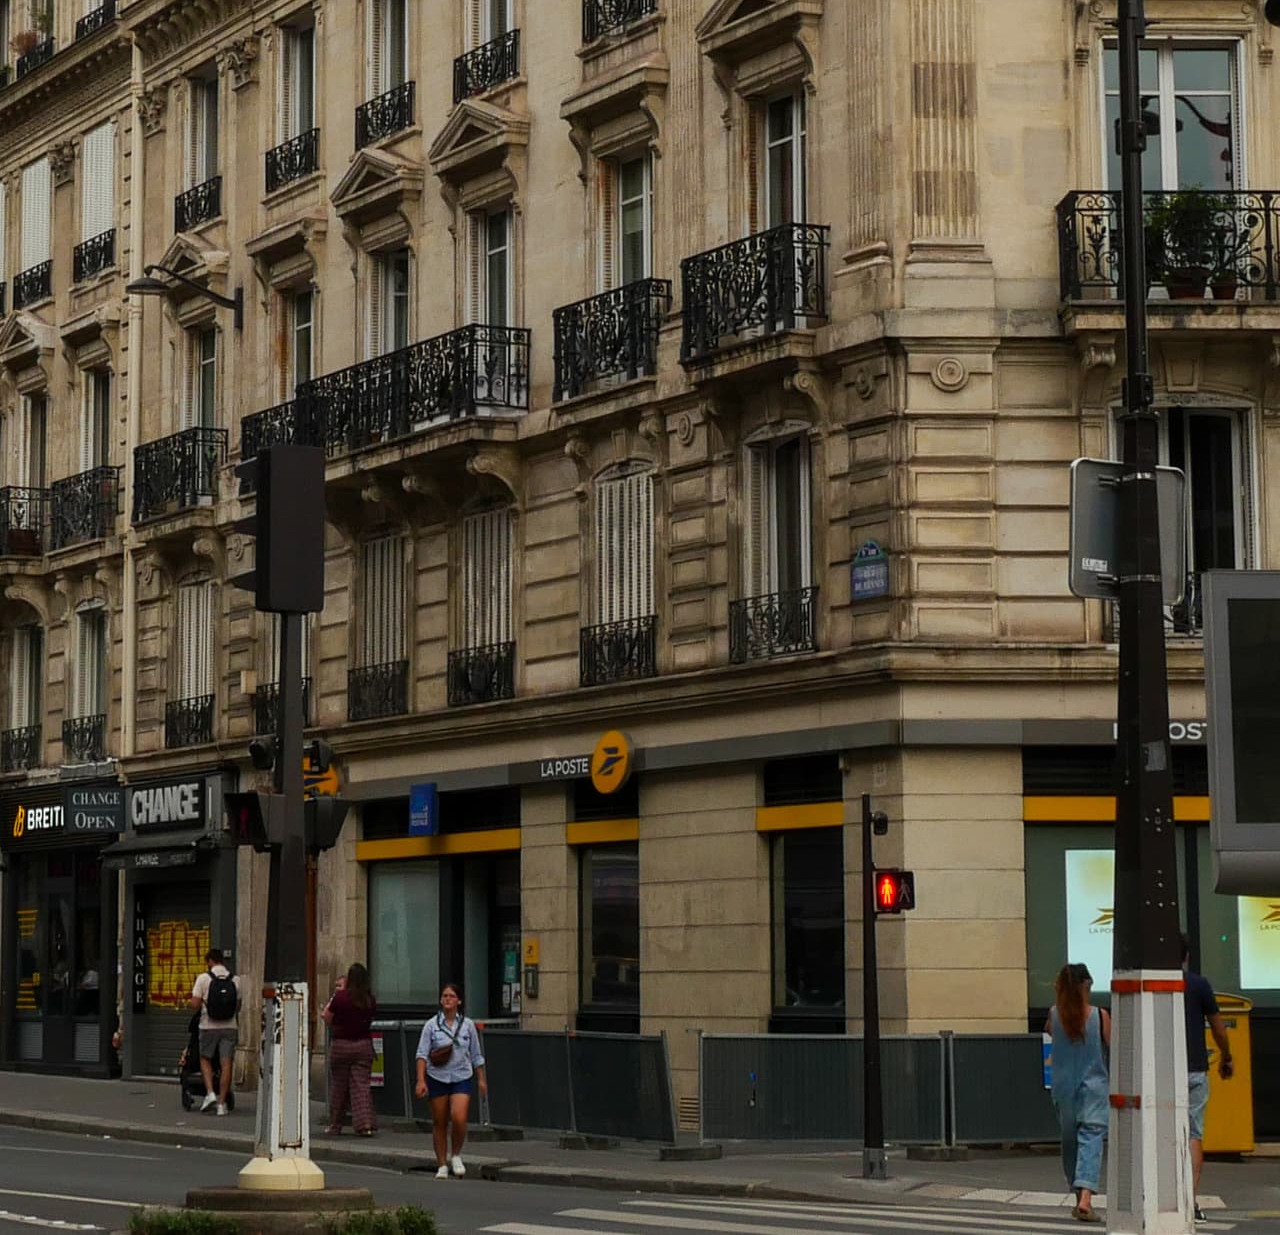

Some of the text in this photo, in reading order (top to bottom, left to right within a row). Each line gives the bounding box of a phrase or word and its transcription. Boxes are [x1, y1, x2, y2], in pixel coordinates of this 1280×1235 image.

[541, 758, 589, 777] LA POSTE
[72, 791, 120, 806] CHANGE
[131, 782, 200, 826] CHANGE
[135, 902, 145, 1004] CHANGE
